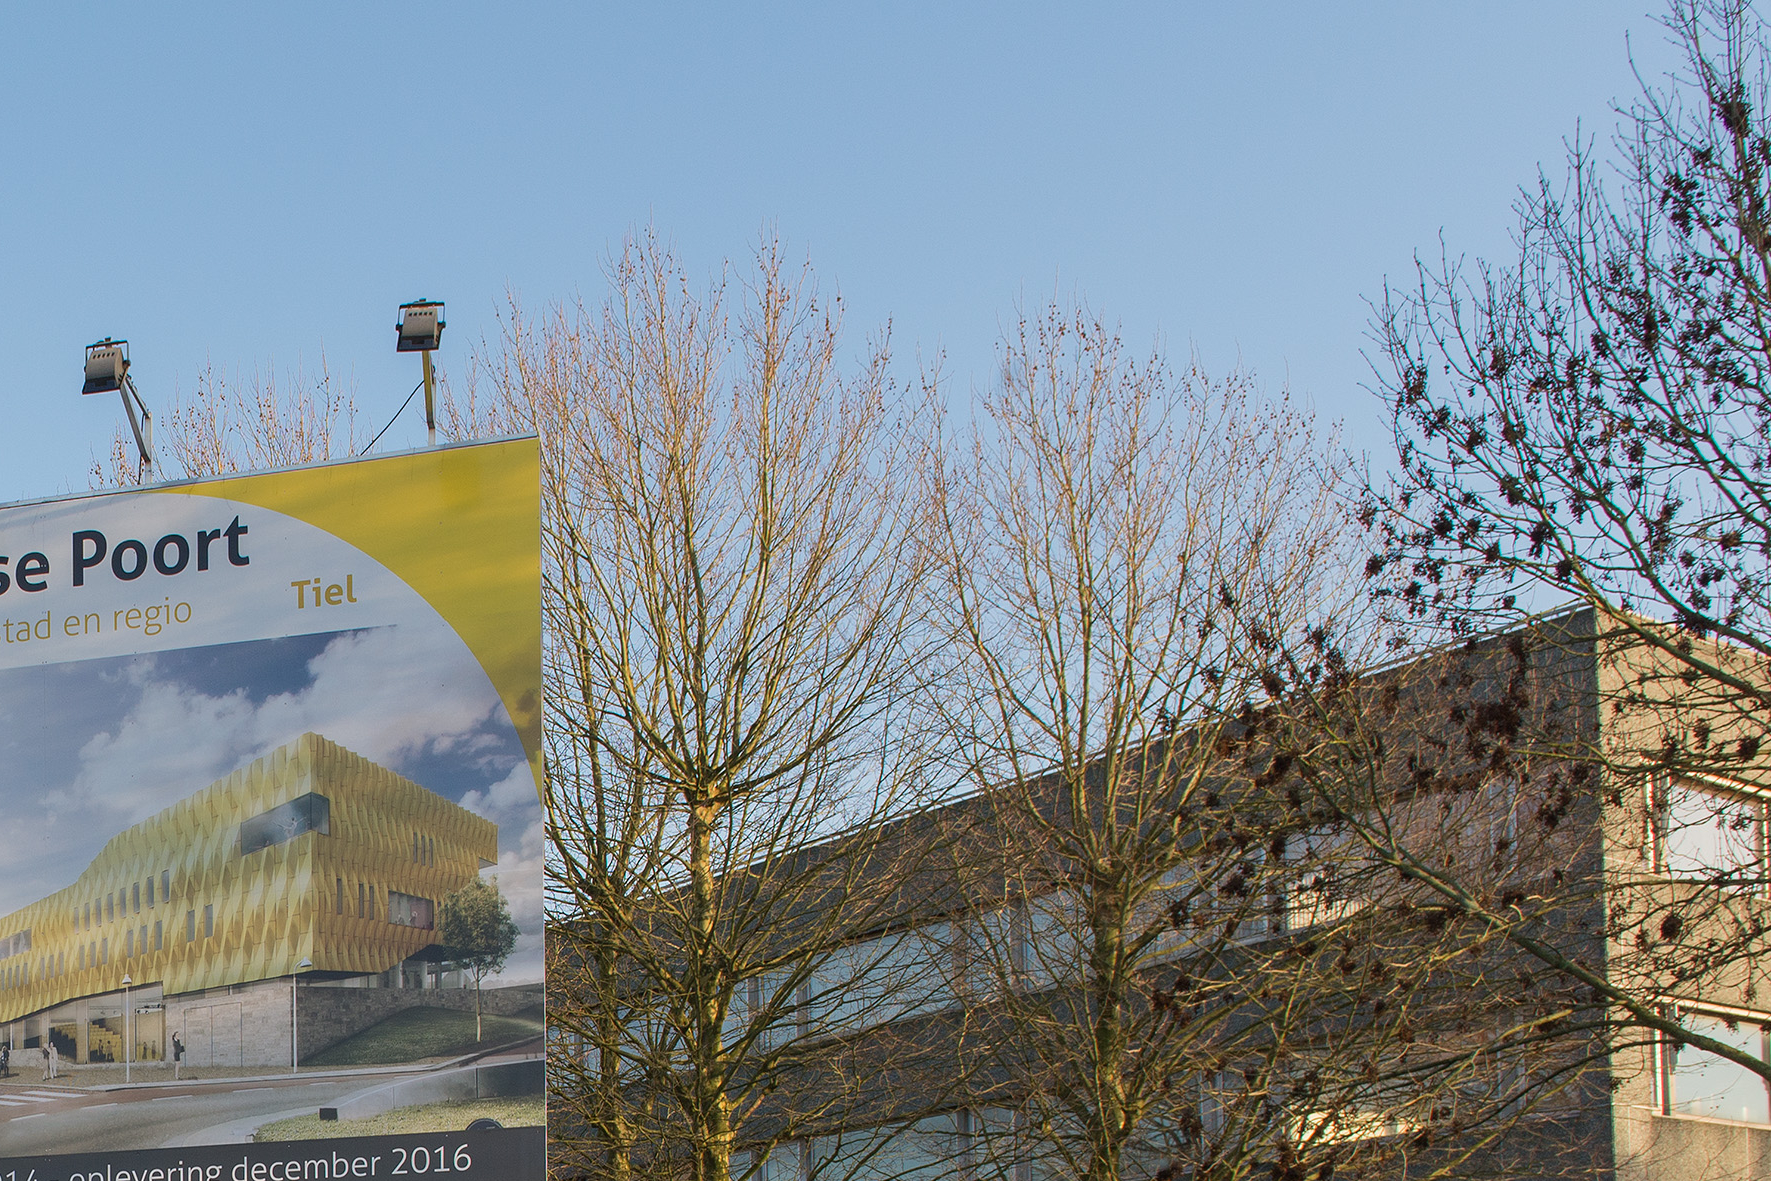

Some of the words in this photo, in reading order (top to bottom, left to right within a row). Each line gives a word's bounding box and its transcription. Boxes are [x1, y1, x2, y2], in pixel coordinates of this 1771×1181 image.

[73, 515, 249, 586] Poort
[291, 574, 357, 608] Tiel
[64, 613, 100, 636] en
[114, 597, 191, 635] regio
[392, 1144, 471, 1174] 2016
